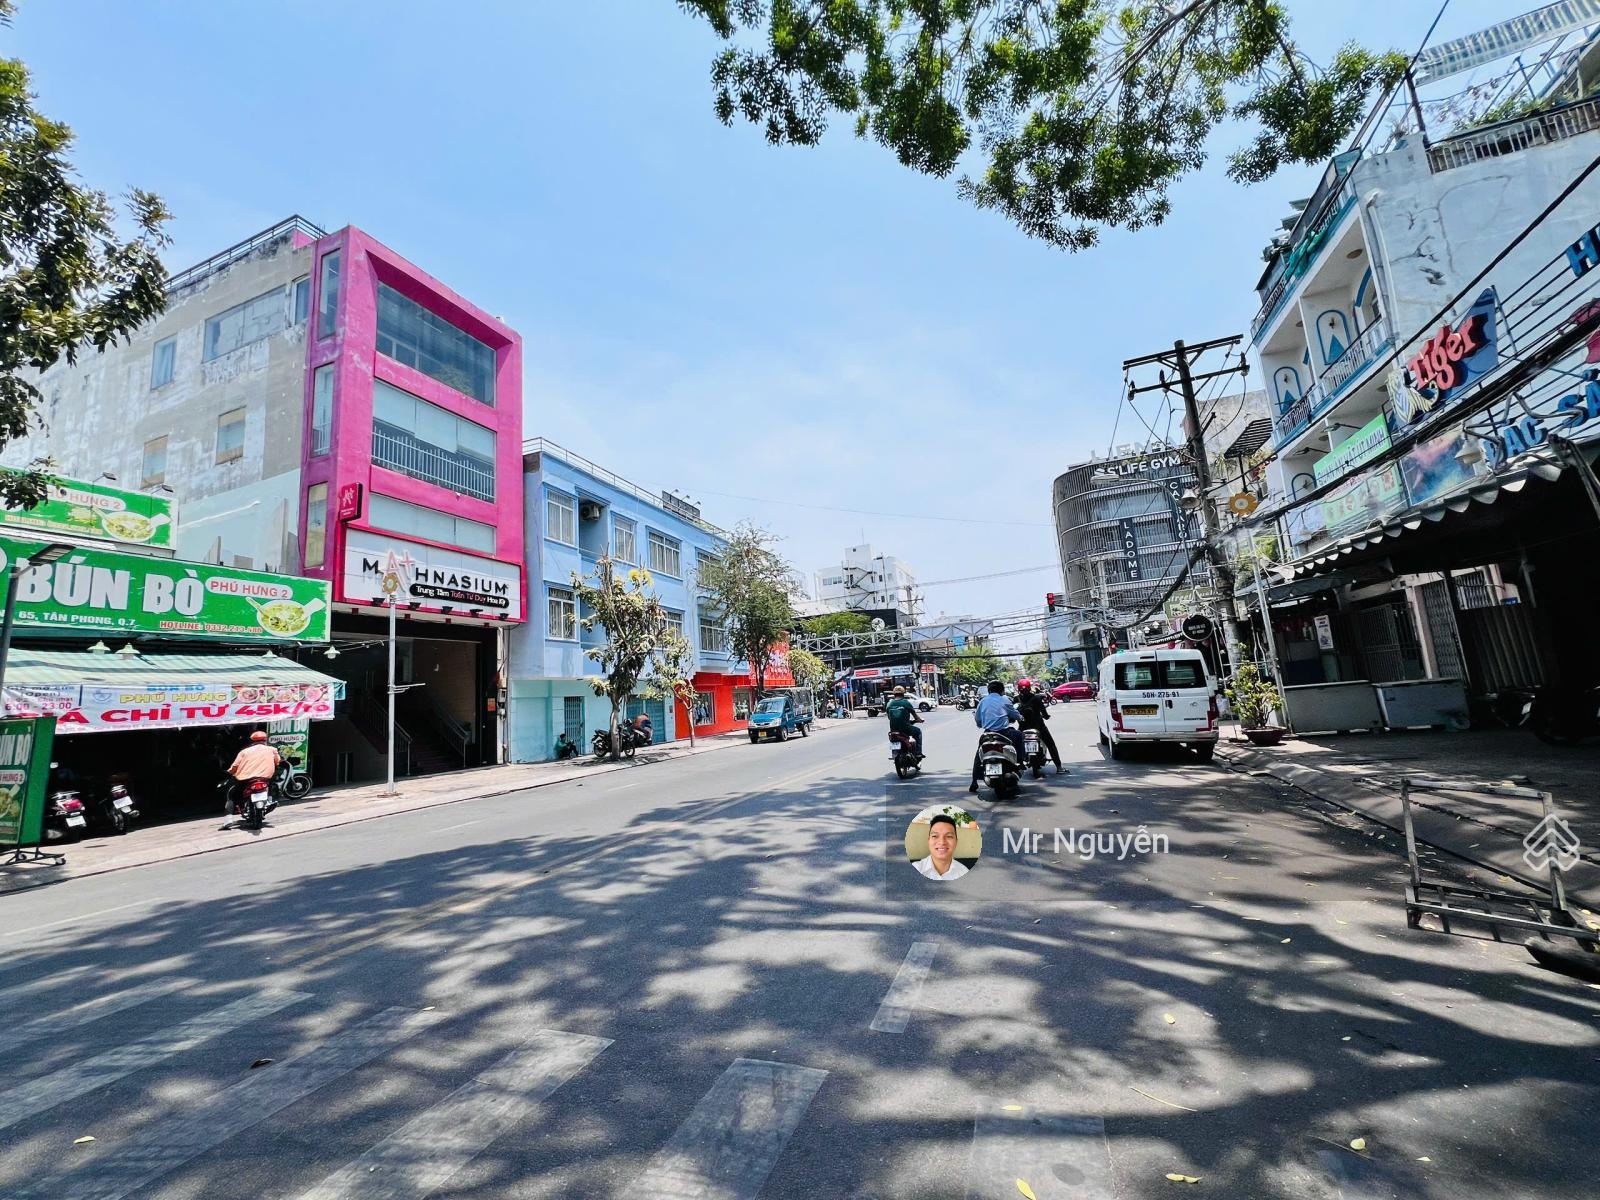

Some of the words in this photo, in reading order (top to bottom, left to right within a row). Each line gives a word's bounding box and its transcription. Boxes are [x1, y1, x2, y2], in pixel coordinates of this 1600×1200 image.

[1407, 316, 1476, 391] Tiger
[1150, 455, 1181, 470] GYM
[113, 502, 121, 510] 2
[1123, 521, 1138, 578] LADOME
[15, 556, 130, 610] BÚN
[143, 569, 204, 616] BÒ
[210, 580, 238, 592] PHÚ
[242, 584, 277, 597] HƯNG
[281, 590, 288, 598] 2
[416, 586, 435, 597] Trung
[43, 612, 67, 622] TÂN
[120, 691, 166, 704] PHÚ
[171, 692, 228, 703] HƯNG
[101, 703, 172, 723] CHỈ
[180, 703, 230, 719] TỪ
